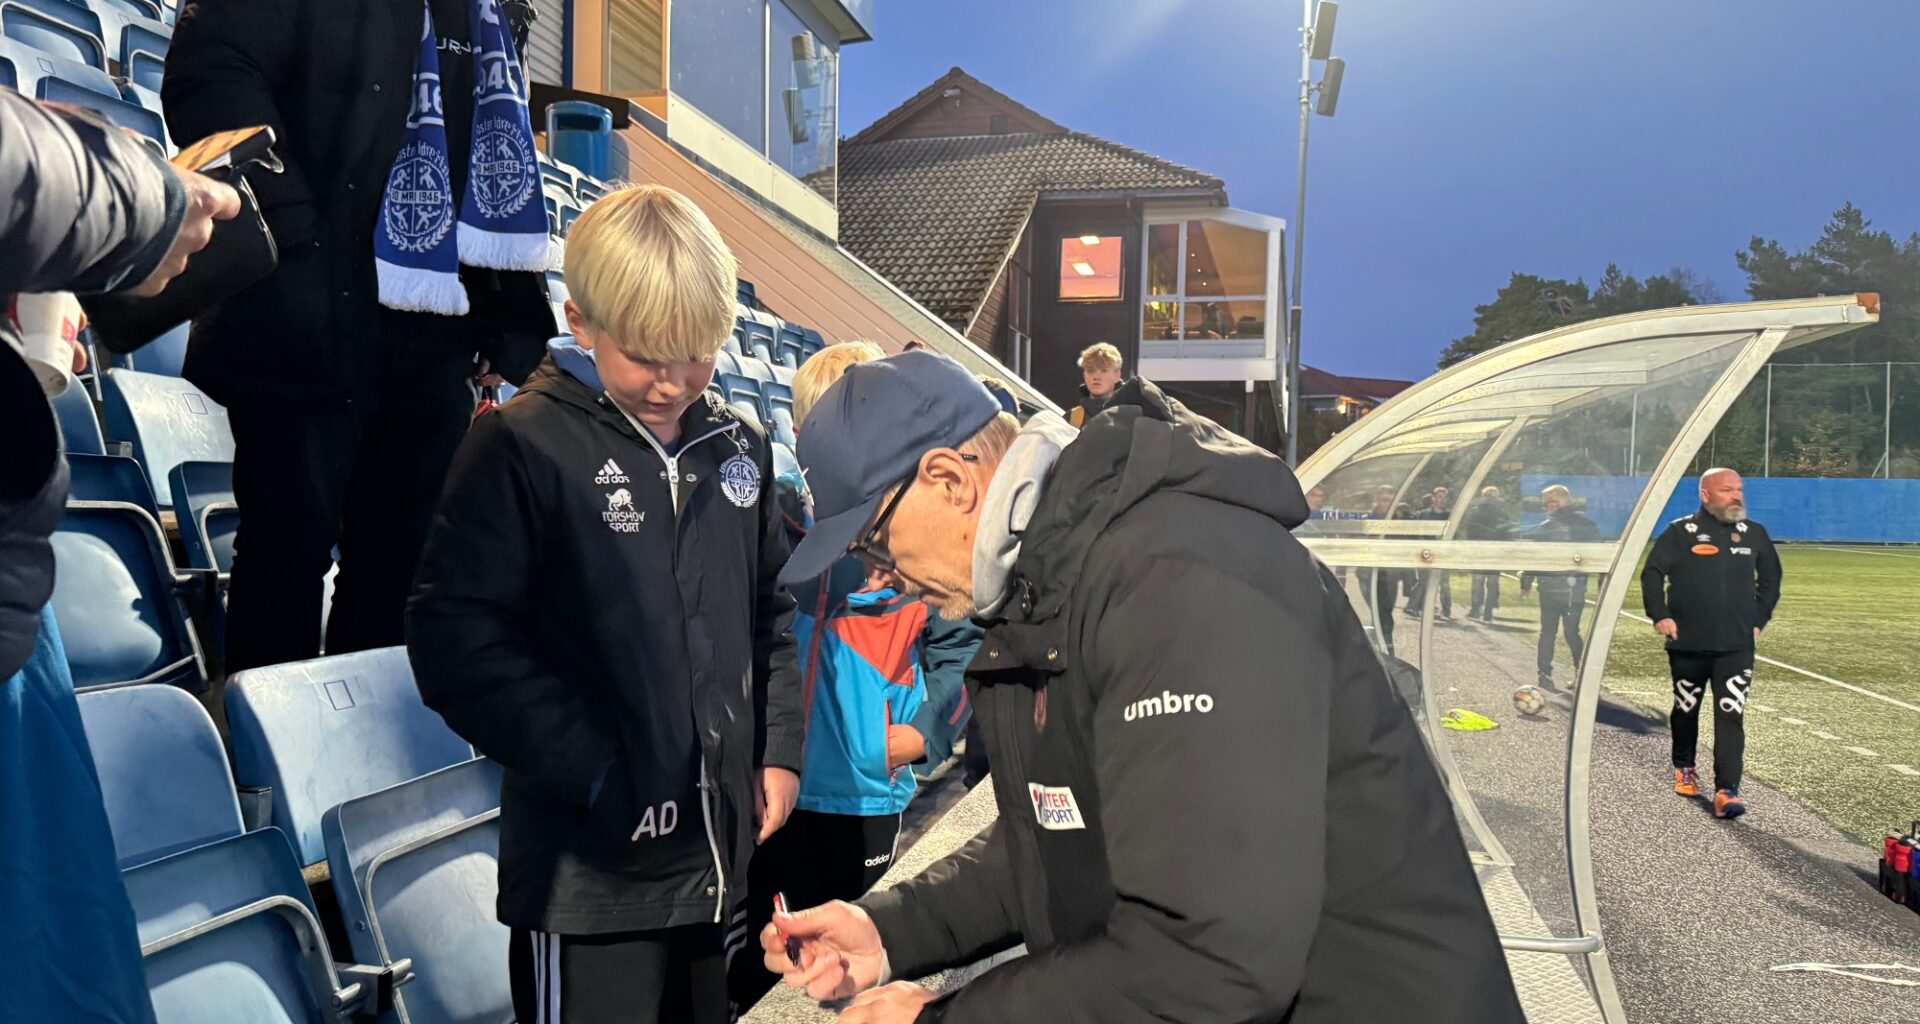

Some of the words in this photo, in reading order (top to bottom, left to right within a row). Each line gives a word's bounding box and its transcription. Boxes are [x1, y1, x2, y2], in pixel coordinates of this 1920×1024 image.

[498, 161, 518, 172] 1946
[419, 191, 440, 201] 1946
[594, 474, 630, 484] addas
[602, 511, 645, 522] TORSHOV
[609, 522, 640, 533] SPORT
[1124, 690, 1214, 721] umbro
[631, 800, 678, 841] AD
